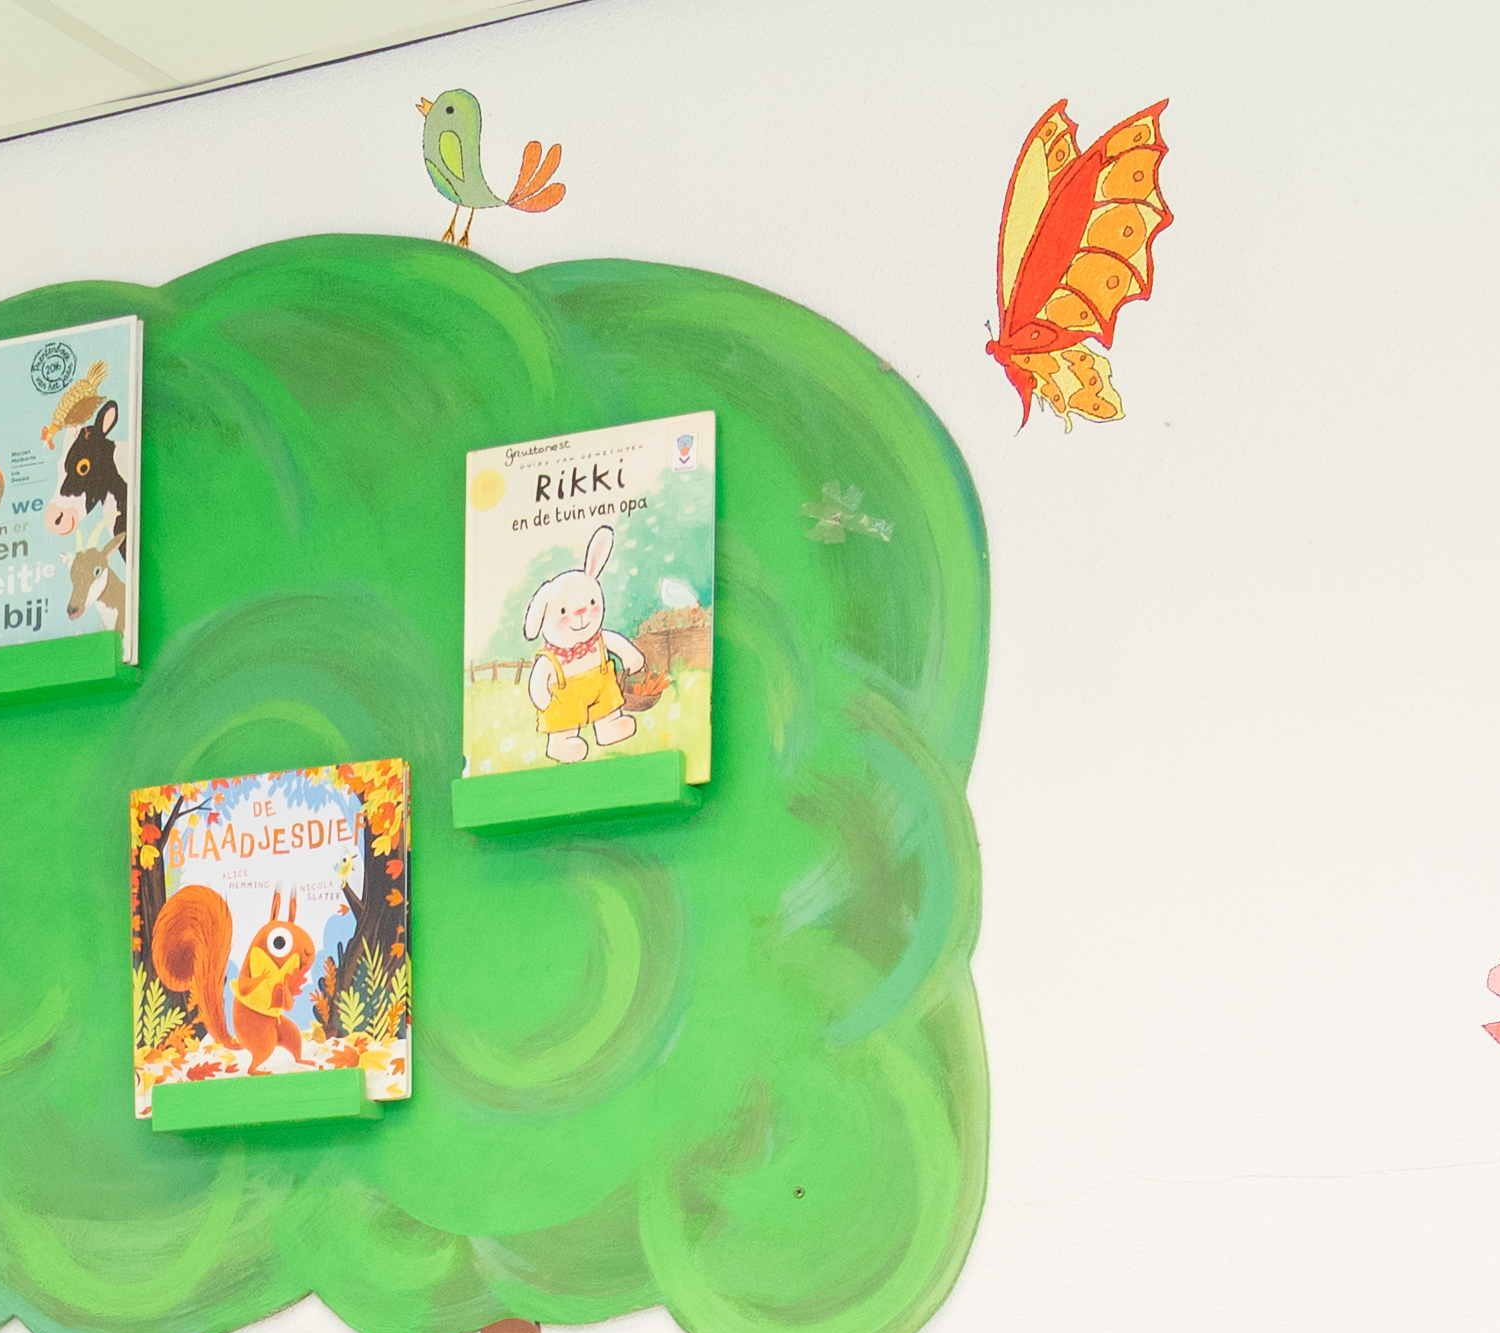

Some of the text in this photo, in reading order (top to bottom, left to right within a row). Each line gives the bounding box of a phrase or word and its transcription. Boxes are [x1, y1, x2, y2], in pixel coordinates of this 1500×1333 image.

[535, 458, 626, 503] Rikki
[11, 498, 44, 515] we
[512, 496, 649, 532] en de tuin van opa
[13, 521, 30, 534] er
[253, 800, 277, 818] DE
[168, 811, 368, 869] BLAADJESDIEF
[222, 868, 249, 880] ALICE
[228, 880, 270, 890] HEMMING
[300, 880, 334, 892] NICOLA
[306, 892, 341, 901] SLATER
